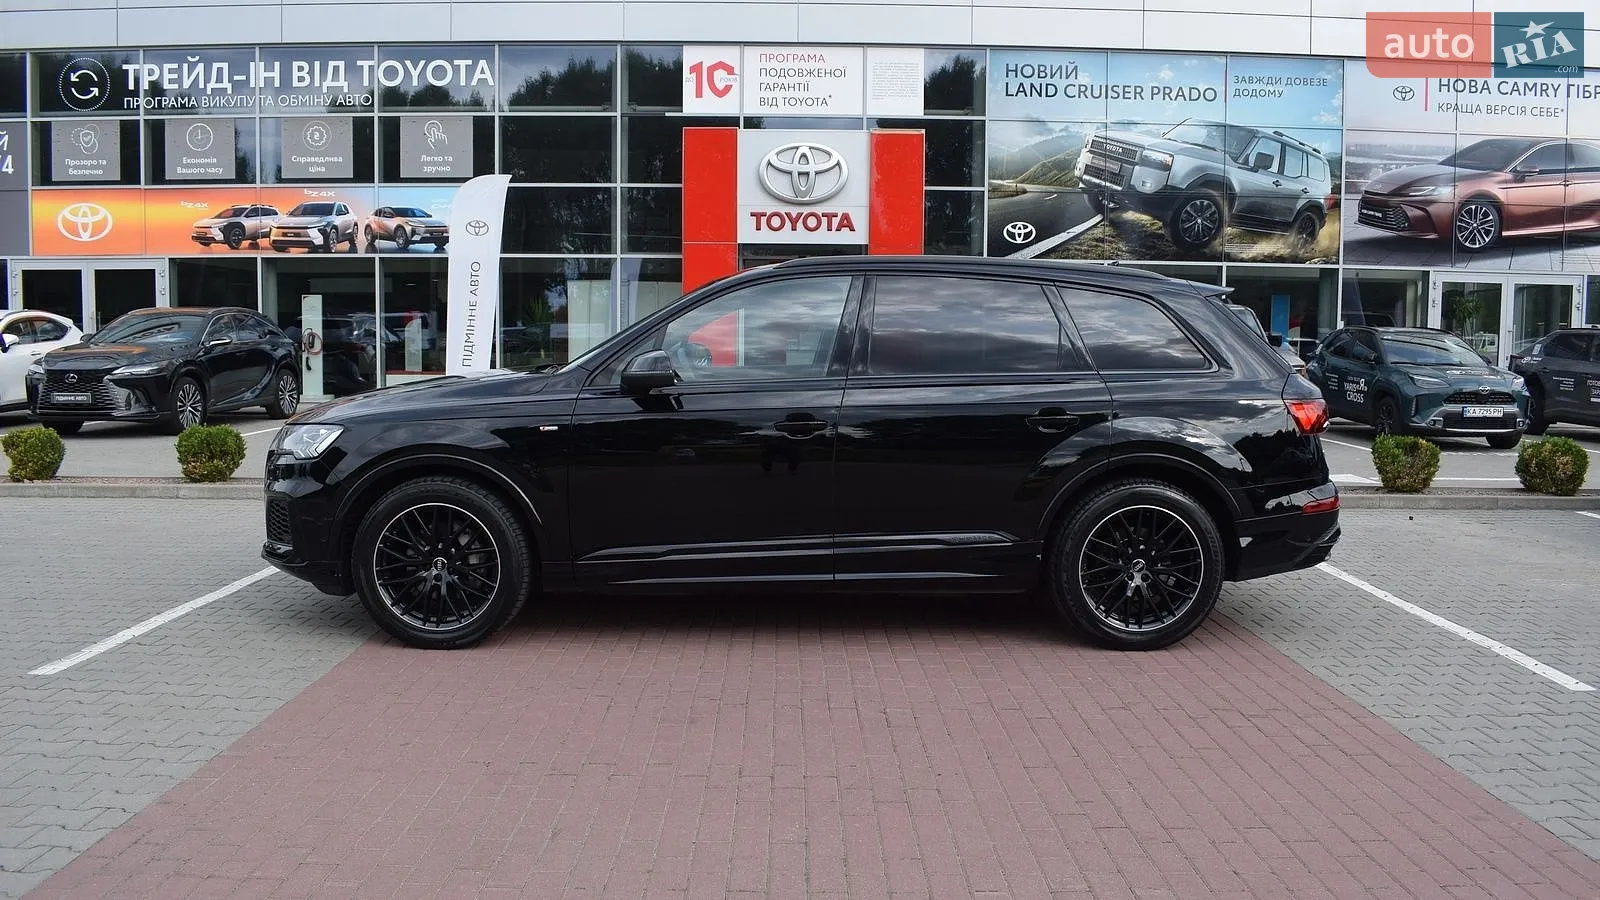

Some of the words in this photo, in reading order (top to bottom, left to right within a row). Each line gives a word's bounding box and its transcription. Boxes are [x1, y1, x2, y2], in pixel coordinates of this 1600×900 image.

[759, 53, 826, 63] ПРОГРАМА
[122, 55, 280, 95] ТРЕЙД-ІН
[292, 60, 349, 93] ВІД
[356, 59, 495, 87] TOYOTA
[759, 66, 848, 79] ПОДОВЖЕНОЇ
[1005, 61, 1079, 80] НОВИЙ
[759, 81, 810, 92] ГАРАНТІЇ
[1233, 75, 1282, 87] ЗАВЖДИ
[1285, 77, 1328, 88] ДОВЕЗЕ
[1438, 77, 1491, 95] НОВА
[1495, 81, 1562, 98] CAMRY
[1005, 81, 1058, 98] LAND
[1063, 83, 1140, 100] CRUISER
[1150, 86, 1216, 102] PRADO
[1233, 88, 1284, 99] ДОДОМУ
[124, 97, 198, 109] ПРОГРАМА
[201, 96, 256, 108] ВИКУПУ
[259, 95, 275, 107] ТА
[278, 95, 333, 107] ОБМІНУ
[335, 94, 373, 107] АВТО
[759, 97, 778, 108] ВІД
[1437, 102, 1482, 115] КРАЩА
[1486, 104, 1528, 116] ВЕРСІЯ
[750, 211, 856, 232] TOYOTA
[461, 300, 478, 368] ПІДМІННЕ
[470, 261, 481, 297] АВТО
